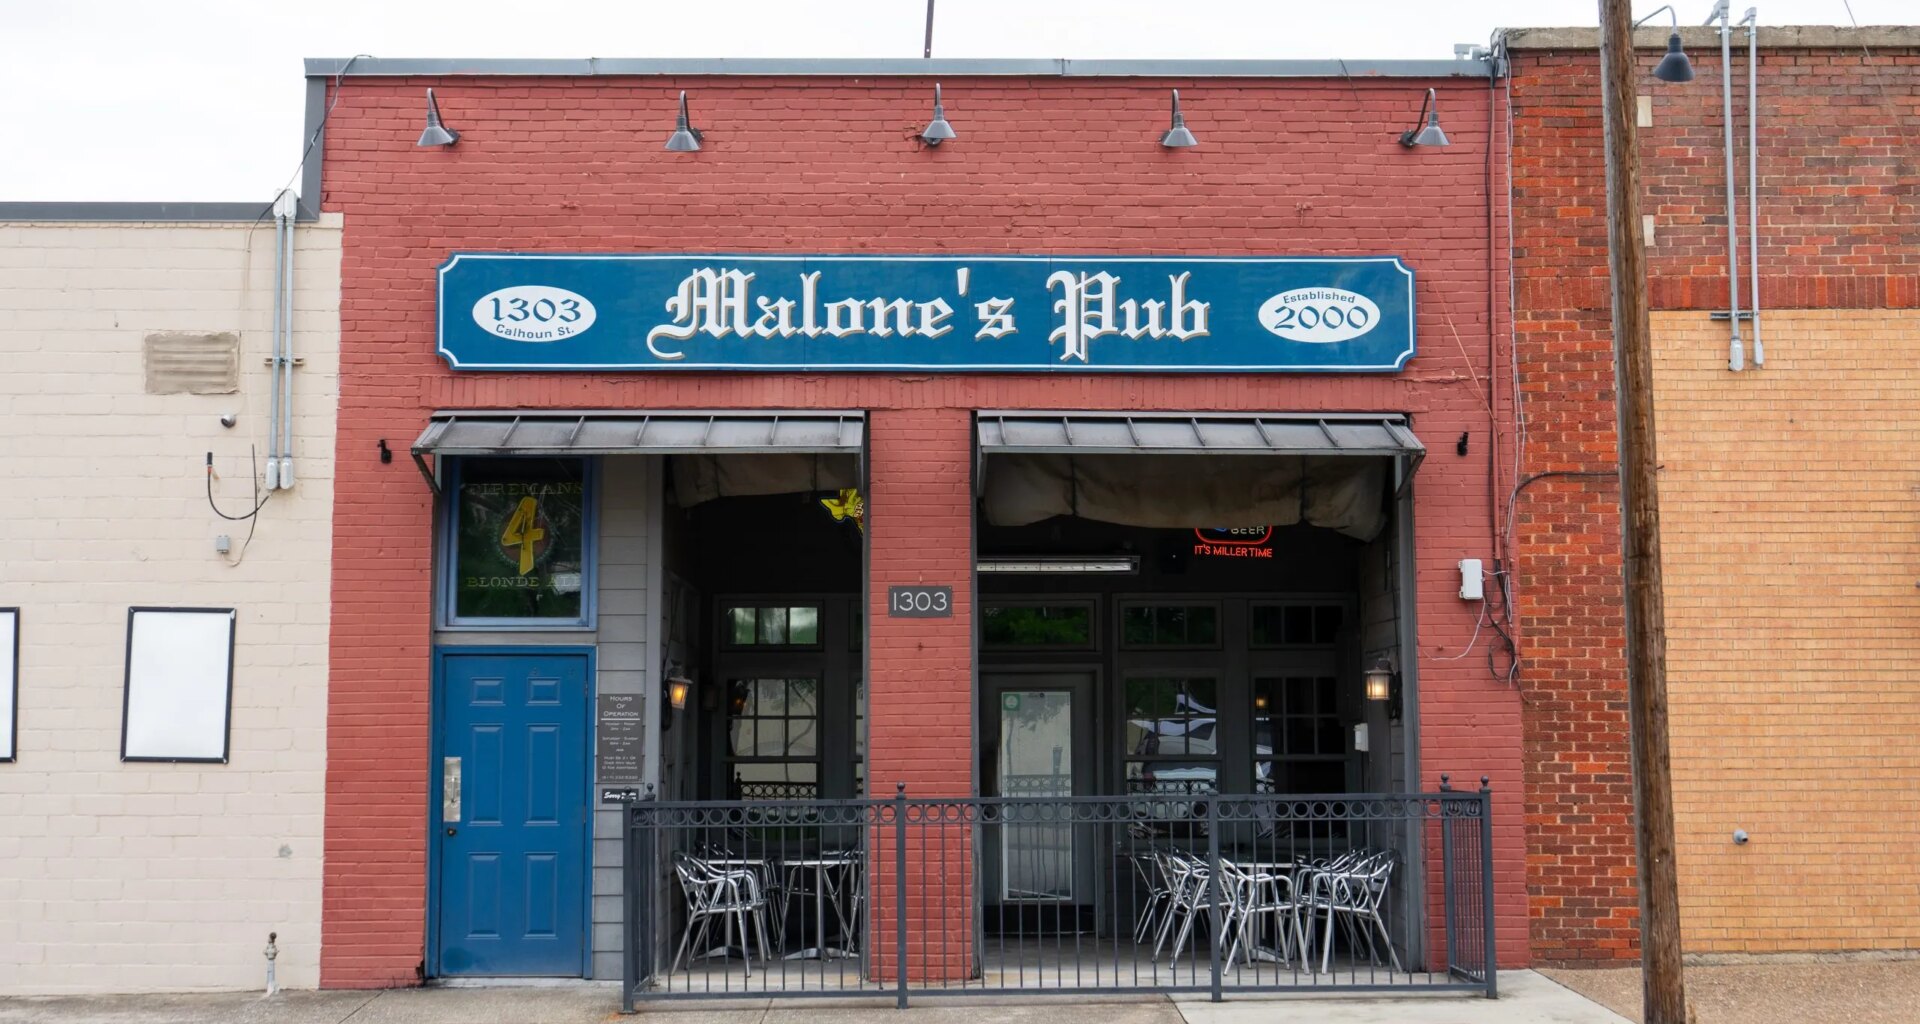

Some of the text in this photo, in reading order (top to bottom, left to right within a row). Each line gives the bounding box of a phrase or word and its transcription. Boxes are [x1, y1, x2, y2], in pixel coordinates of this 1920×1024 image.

[1283, 290, 1356, 305] Established
[489, 297, 582, 322] 1303
[647, 266, 1211, 363] Malone's Pub
[1274, 305, 1369, 330] 2000
[496, 324, 575, 339] Calhoun St.
[501, 496, 545, 576] 4
[1231, 526, 1265, 534] BEER
[1194, 544, 1273, 558] IT'S MILLER TIME
[467, 576, 538, 587] BLONDE
[893, 592, 947, 611] 1303
